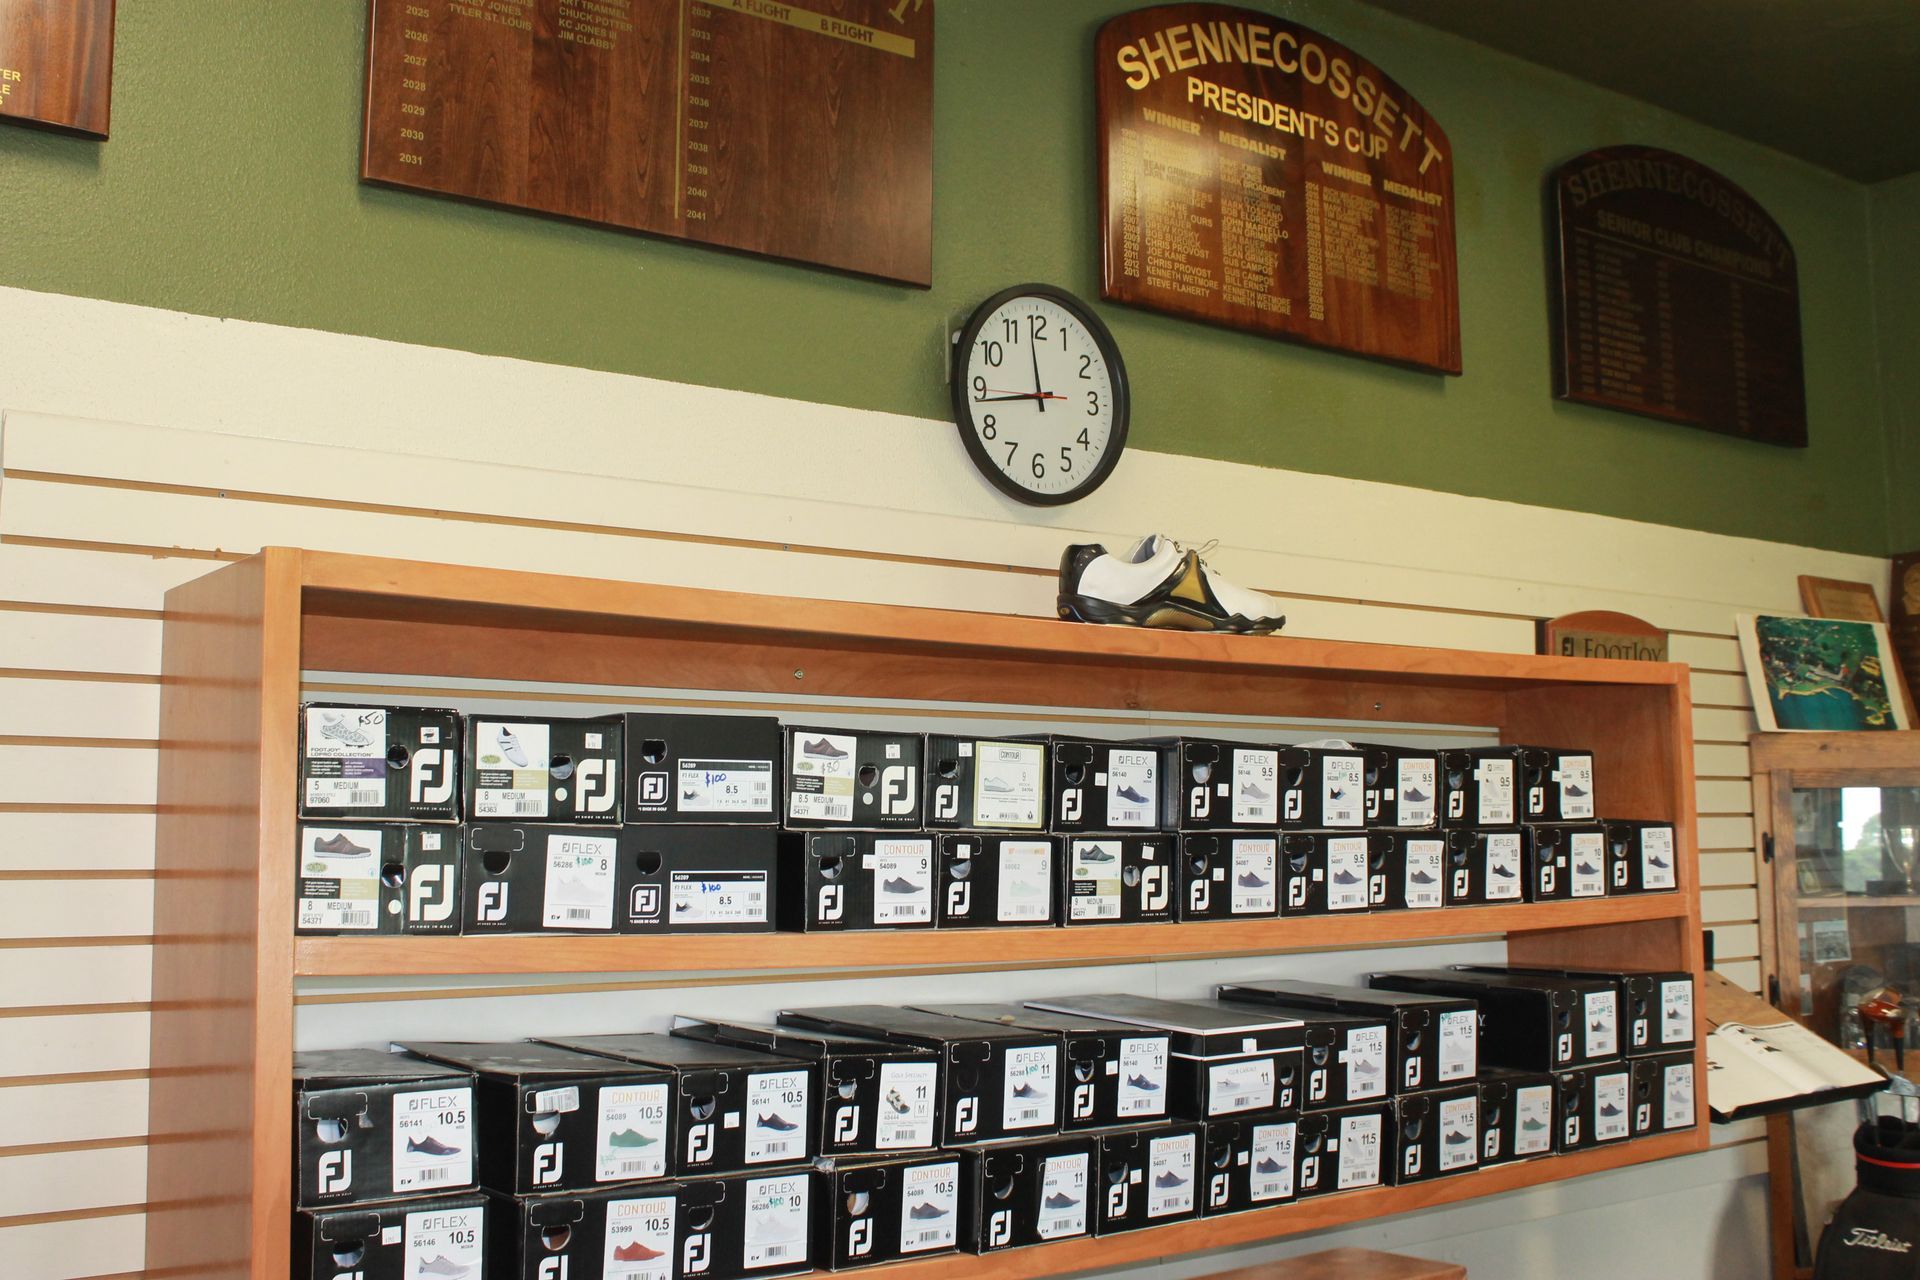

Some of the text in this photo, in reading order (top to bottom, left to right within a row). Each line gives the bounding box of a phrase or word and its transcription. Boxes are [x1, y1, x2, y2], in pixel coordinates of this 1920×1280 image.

[406, 5, 429, 18] 2025
[582, 2, 628, 19] TRAMMEL
[691, 7, 711, 18] 2032
[746, 0, 791, 21] FLIGHT
[449, 3, 481, 18] TYLER
[502, 16, 532, 31] LOUIS
[559, 7, 632, 32] CHUCK POTTER
[559, 19, 572, 28] KC
[575, 23, 606, 36] JONES
[821, 19, 874, 43] B FLIGHT
[405, 30, 428, 42] 2026
[558, 31, 615, 50] JIM CLABBY
[691, 29, 711, 40] 2033
[404, 54, 427, 67] 2027
[690, 51, 710, 63] 2034
[403, 79, 426, 91] 2028
[690, 74, 710, 85] 2035
[689, 96, 709, 107] 2036
[1117, 22, 1443, 174] SHENNECOSSETT
[401, 103, 425, 116] 2029
[689, 118, 708, 129] 2037
[1143, 107, 1201, 136] WINNER
[1188, 76, 1389, 159] PRESIDENT'S CUP
[401, 128, 424, 140] 2030
[688, 141, 708, 152] 2038
[1219, 130, 1287, 160] MEDALIST
[400, 153, 422, 165] 2031
[688, 164, 707, 175] 2039
[1322, 161, 1371, 186] WINNER
[687, 186, 707, 198] 2040
[1383, 179, 1443, 206] MEDALIST
[687, 209, 706, 220] 2041
[1567, 159, 1793, 274] SHENNECOSSETT
[1597, 210, 1652, 242] SENIOR
[1655, 228, 1692, 254] CLUB
[1146, 237, 1209, 259] CHRIS PROVOST
[1165, 251, 1186, 263] KANE
[1124, 267, 1139, 277] 2013
[1148, 257, 1212, 279] CHRIS PROVOST
[1147, 266, 1219, 289] KENNETH WETMORE
[1147, 276, 1210, 297] STEVE FLAHERTY
[1003, 319, 1018, 344] 11
[1027, 315, 1047, 340] 12
[1060, 328, 1066, 351] 1
[981, 341, 1003, 367] 10
[1079, 355, 1091, 379] 2
[974, 376, 986, 399] 9
[1087, 391, 1098, 416] 3
[983, 414, 996, 440] 8
[1077, 428, 1090, 451] 4
[1005, 442, 1018, 466] 7
[1060, 447, 1072, 472] 5
[1032, 453, 1044, 479] 6
[359, 712, 384, 727] $50
[1001, 751, 1019, 759] CONTOUR
[411, 749, 453, 803] FJ
[1147, 769, 1152, 778] 9
[1262, 768, 1272, 776] 9.5
[1349, 773, 1359, 782] 8.5
[1423, 774, 1432, 782] 9.5
[576, 759, 615, 811] FJ
[706, 771, 726, 787] $100
[1500, 777, 1510, 787] 9.5
[315, 782, 319, 790] 5
[643, 778, 663, 799] FJ
[726, 785, 738, 794] 8.5
[485, 791, 488, 800] 8
[799, 795, 808, 803] 8.5
[572, 843, 601, 854] FLEX
[884, 844, 924, 855] CONTOUR
[1239, 844, 1270, 852] CONTOUR
[1334, 842, 1362, 851] CONTOUR
[1354, 854, 1364, 863] 9.5
[1511, 849, 1518, 857] 10
[600, 859, 607, 870] 8
[921, 859, 927, 869] 9
[1041, 860, 1047, 870] 9
[1267, 856, 1271, 865] 9
[1429, 856, 1439, 864] 9.5
[410, 865, 454, 921] FJ
[701, 882, 721, 893] $100
[308, 901, 352, 910] 8 MEDIUM
[478, 882, 508, 920] FJ
[635, 890, 656, 912] FJ
[720, 897, 731, 905] 8.5
[819, 885, 843, 920] FJ
[1461, 1026, 1472, 1035] 11.5
[1137, 1044, 1159, 1052] FLEX
[1370, 1043, 1382, 1052] 11.5
[1023, 1052, 1046, 1062] FLEX
[1154, 1056, 1162, 1064] 11
[1041, 1064, 1050, 1074] 11
[769, 1078, 797, 1088] FLEX
[1261, 1072, 1268, 1082] 11
[612, 1090, 660, 1104] CONTOUR
[782, 1092, 802, 1103] 10.5
[916, 1086, 926, 1098] 11
[420, 1096, 458, 1108] FLEX
[639, 1106, 663, 1119] 10.5
[1445, 1103, 1472, 1114] CONTOUR
[400, 1111, 465, 1128] 56141 10.5
[1461, 1113, 1474, 1123] 11.5
[1259, 1128, 1288, 1139] CONTOUR
[1361, 1133, 1376, 1145] 11.5
[688, 1124, 714, 1162] FJ
[1157, 1140, 1189, 1152] CONTOUR
[1276, 1141, 1290, 1150] 11.5
[533, 1142, 563, 1184] FJ
[1183, 1153, 1191, 1162] 11
[319, 1150, 351, 1193] FJ
[1046, 1159, 1081, 1172] CONTOUR
[912, 1168, 951, 1181] CONTOUR
[1075, 1172, 1083, 1183] 11
[768, 1182, 795, 1194] FLEX
[934, 1182, 953, 1193] 10.5
[789, 1195, 800, 1207] 10
[618, 1203, 666, 1216] CONTOUR
[434, 1216, 467, 1229] FLEX
[645, 1218, 669, 1231] 10.5
[449, 1231, 475, 1244] 10.5
[1843, 1228, 1912, 1252] Titleist
[683, 1233, 711, 1273] FJ
